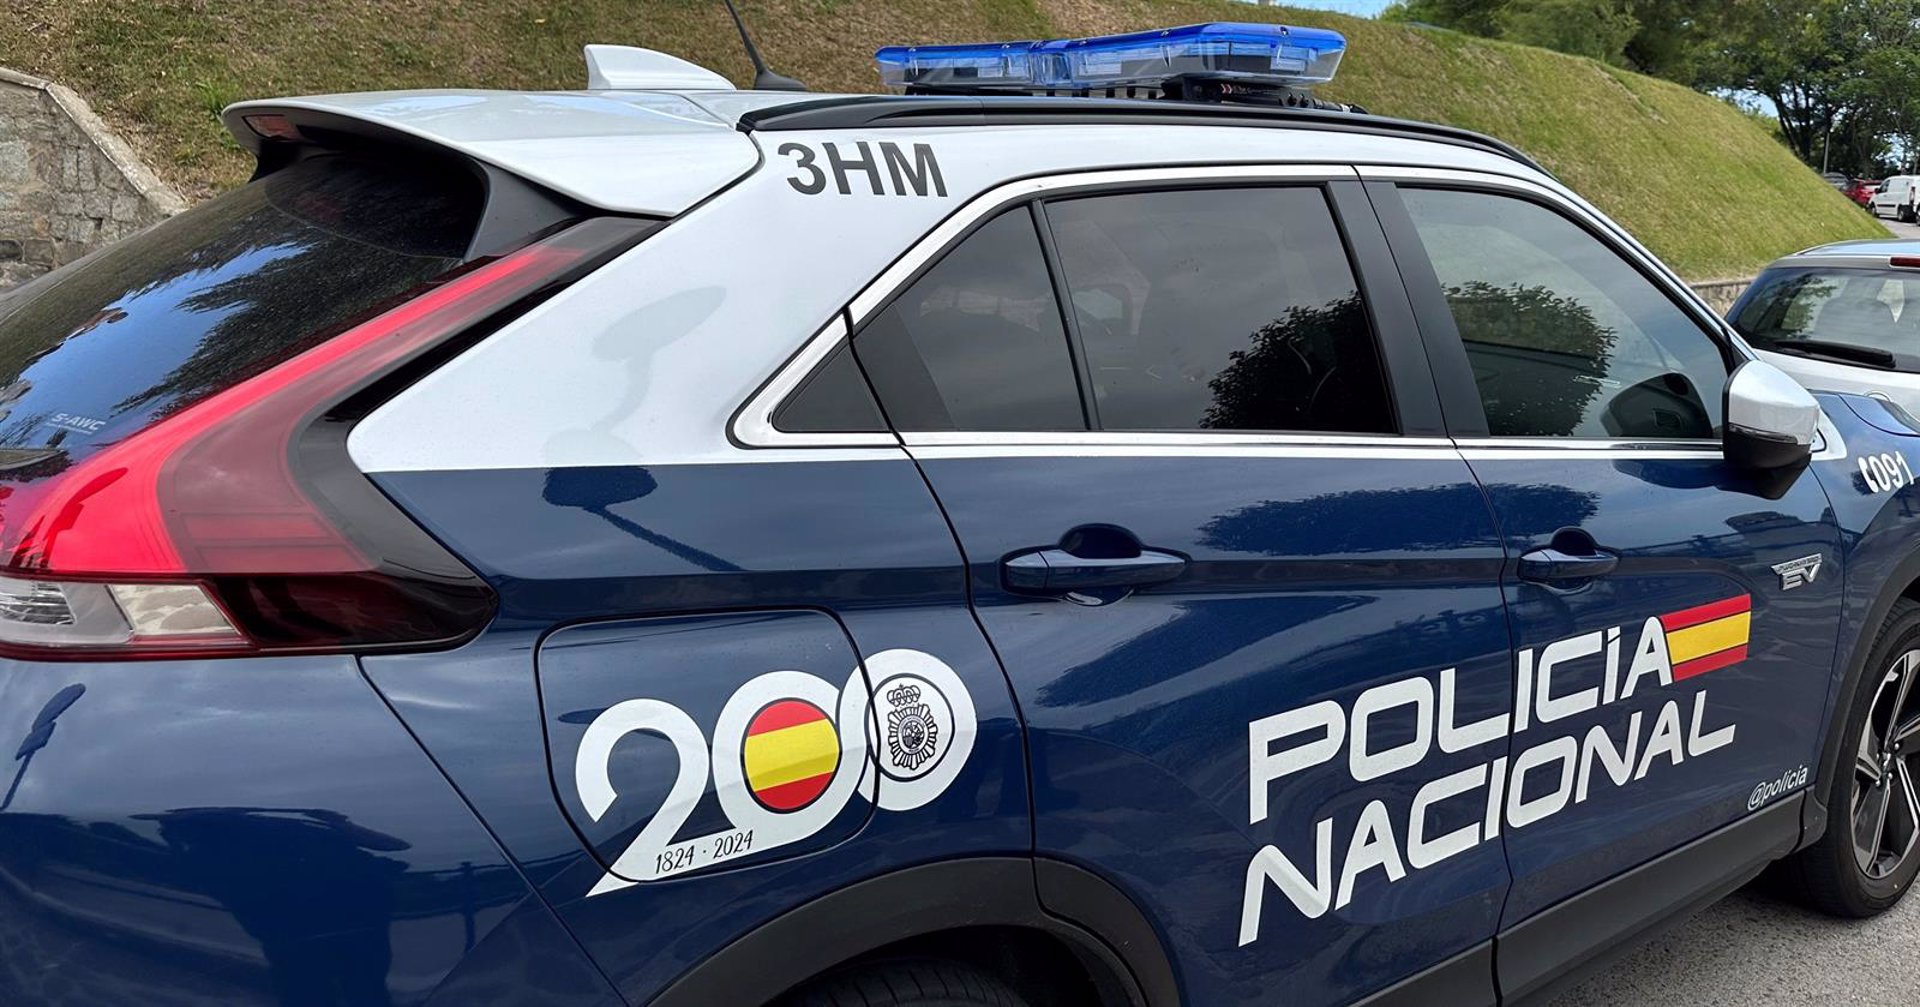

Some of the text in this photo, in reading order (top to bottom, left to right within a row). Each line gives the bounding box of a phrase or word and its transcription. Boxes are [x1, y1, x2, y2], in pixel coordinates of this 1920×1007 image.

[777, 140, 949, 198] 3HM
[51, 412, 107, 431] S-AWC
[1867, 450, 1915, 492] 091
[1782, 563, 1821, 591] EV
[575, 648, 977, 898] 200
[1747, 764, 1808, 811] @policia
[1238, 690, 1736, 948] NACIONAL
[655, 844, 695, 874] 1824
[712, 828, 754, 859] 2024
